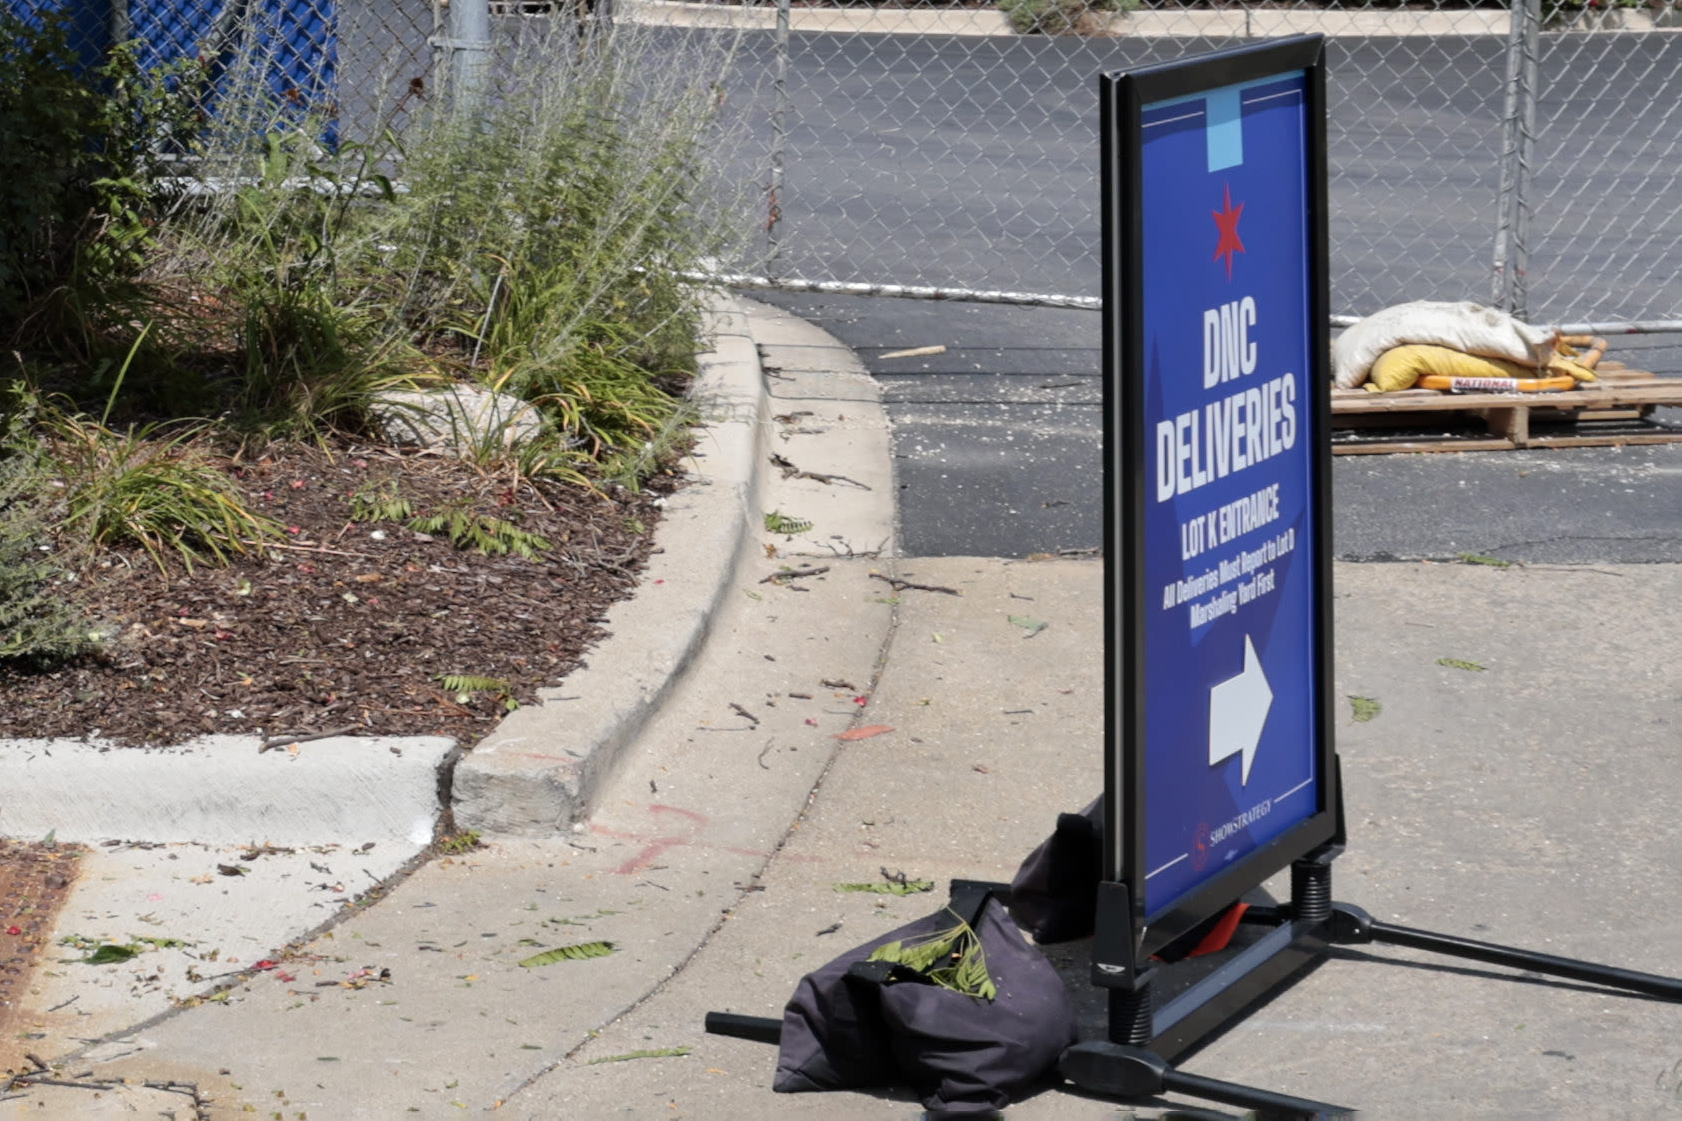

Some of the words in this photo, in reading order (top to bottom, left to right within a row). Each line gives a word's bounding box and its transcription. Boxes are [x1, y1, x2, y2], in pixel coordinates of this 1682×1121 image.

[1203, 295, 1257, 389] DNC
[1454, 378, 1514, 389] NATIONAL
[1156, 372, 1296, 503] DELIVERIES
[1182, 515, 1206, 561] LOT
[1207, 510, 1218, 550] K
[1219, 482, 1280, 544] ENTRANCE
[1163, 583, 1176, 611] All
[1177, 568, 1218, 604] Deliveries
[1219, 555, 1241, 585] Must
[1241, 542, 1268, 575] Report
[1268, 540, 1276, 563] to
[1276, 532, 1289, 557] Lot
[1238, 576, 1256, 606] Yard
[1256, 568, 1276, 597] First
[1209, 797, 1272, 848] SHOWSTRATEGY
